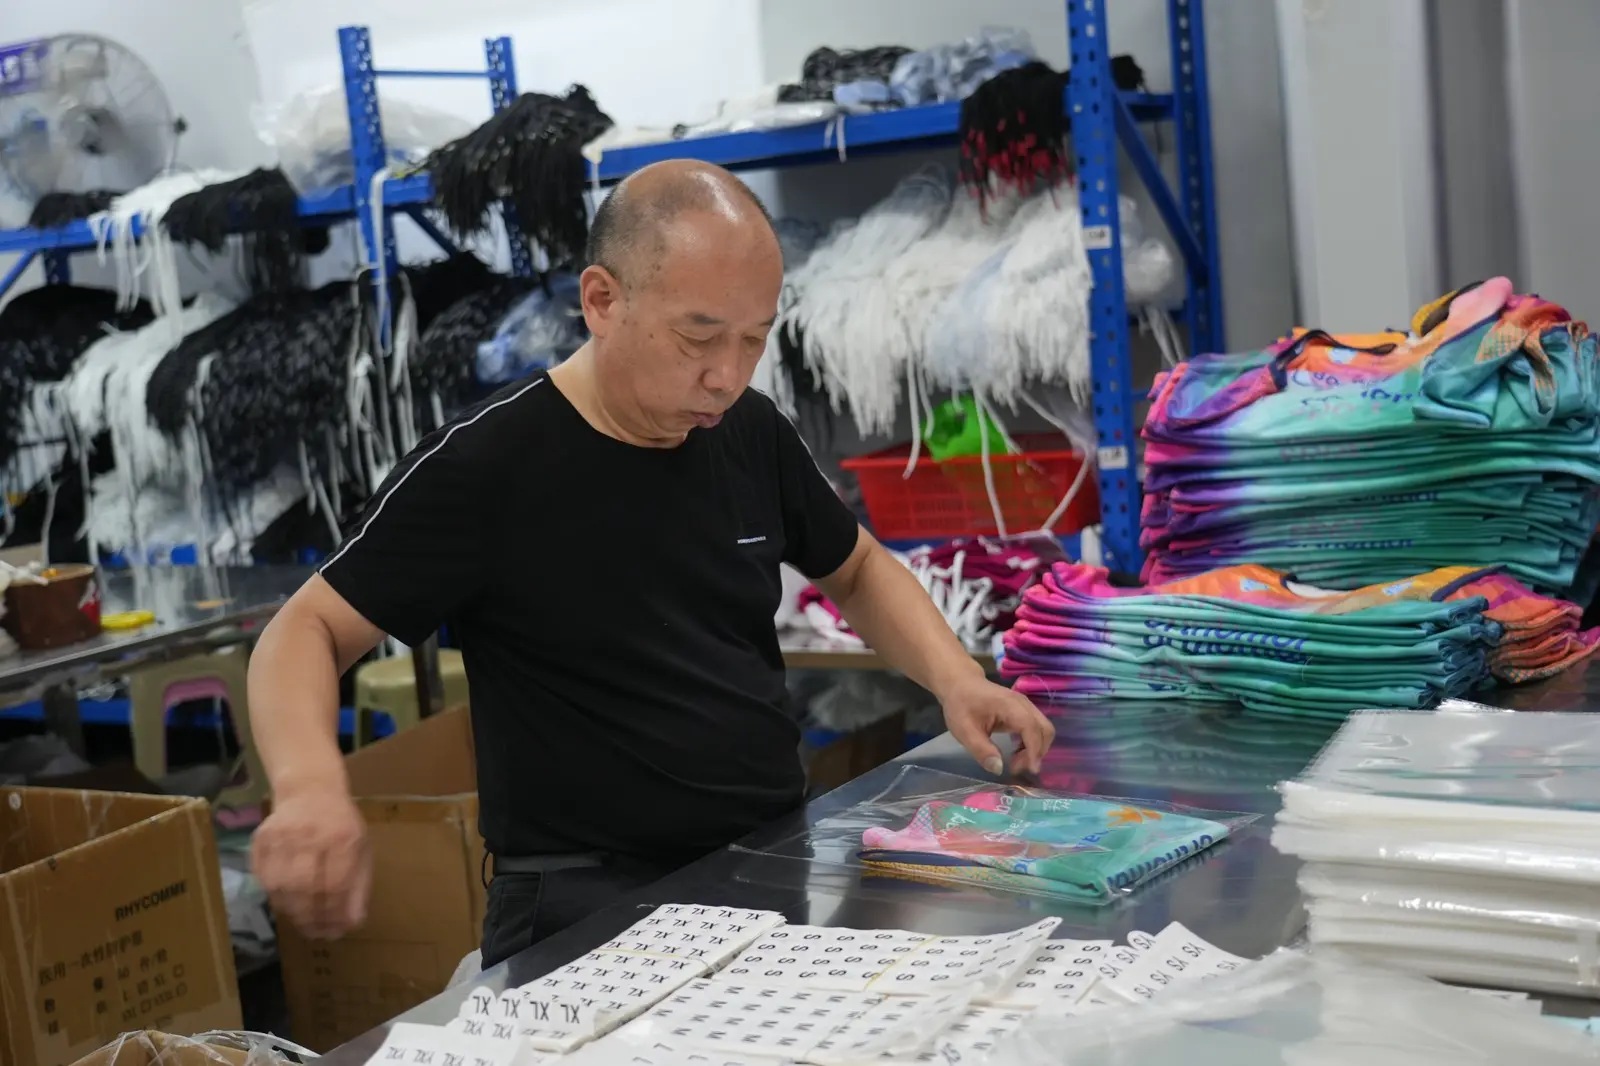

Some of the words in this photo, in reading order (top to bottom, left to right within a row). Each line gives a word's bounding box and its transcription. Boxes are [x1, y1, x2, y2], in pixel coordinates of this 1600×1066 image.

[718, 910, 738, 918] XL
[673, 919, 692, 927] XL
[700, 921, 720, 930] XL
[728, 924, 748, 932] XL
[654, 930, 674, 938] XL
[681, 934, 700, 942] XL
[708, 936, 729, 944] XL
[633, 943, 654, 951] XL
[614, 955, 634, 964] XL
[641, 958, 660, 966] XL
[670, 961, 690, 970] XL
[1036, 955, 1056, 963] S
[564, 966, 585, 974] XL
[592, 968, 612, 976] XL
[620, 971, 640, 979] XL
[649, 974, 669, 984] XL
[544, 979, 561, 987] XL
[571, 981, 590, 990] XL
[599, 984, 620, 993] XL
[628, 988, 648, 997] XL
[473, 996, 491, 1016] XL
[502, 998, 520, 1018] XL
[530, 1000, 549, 1021] XL
[560, 1004, 580, 1024] XL
